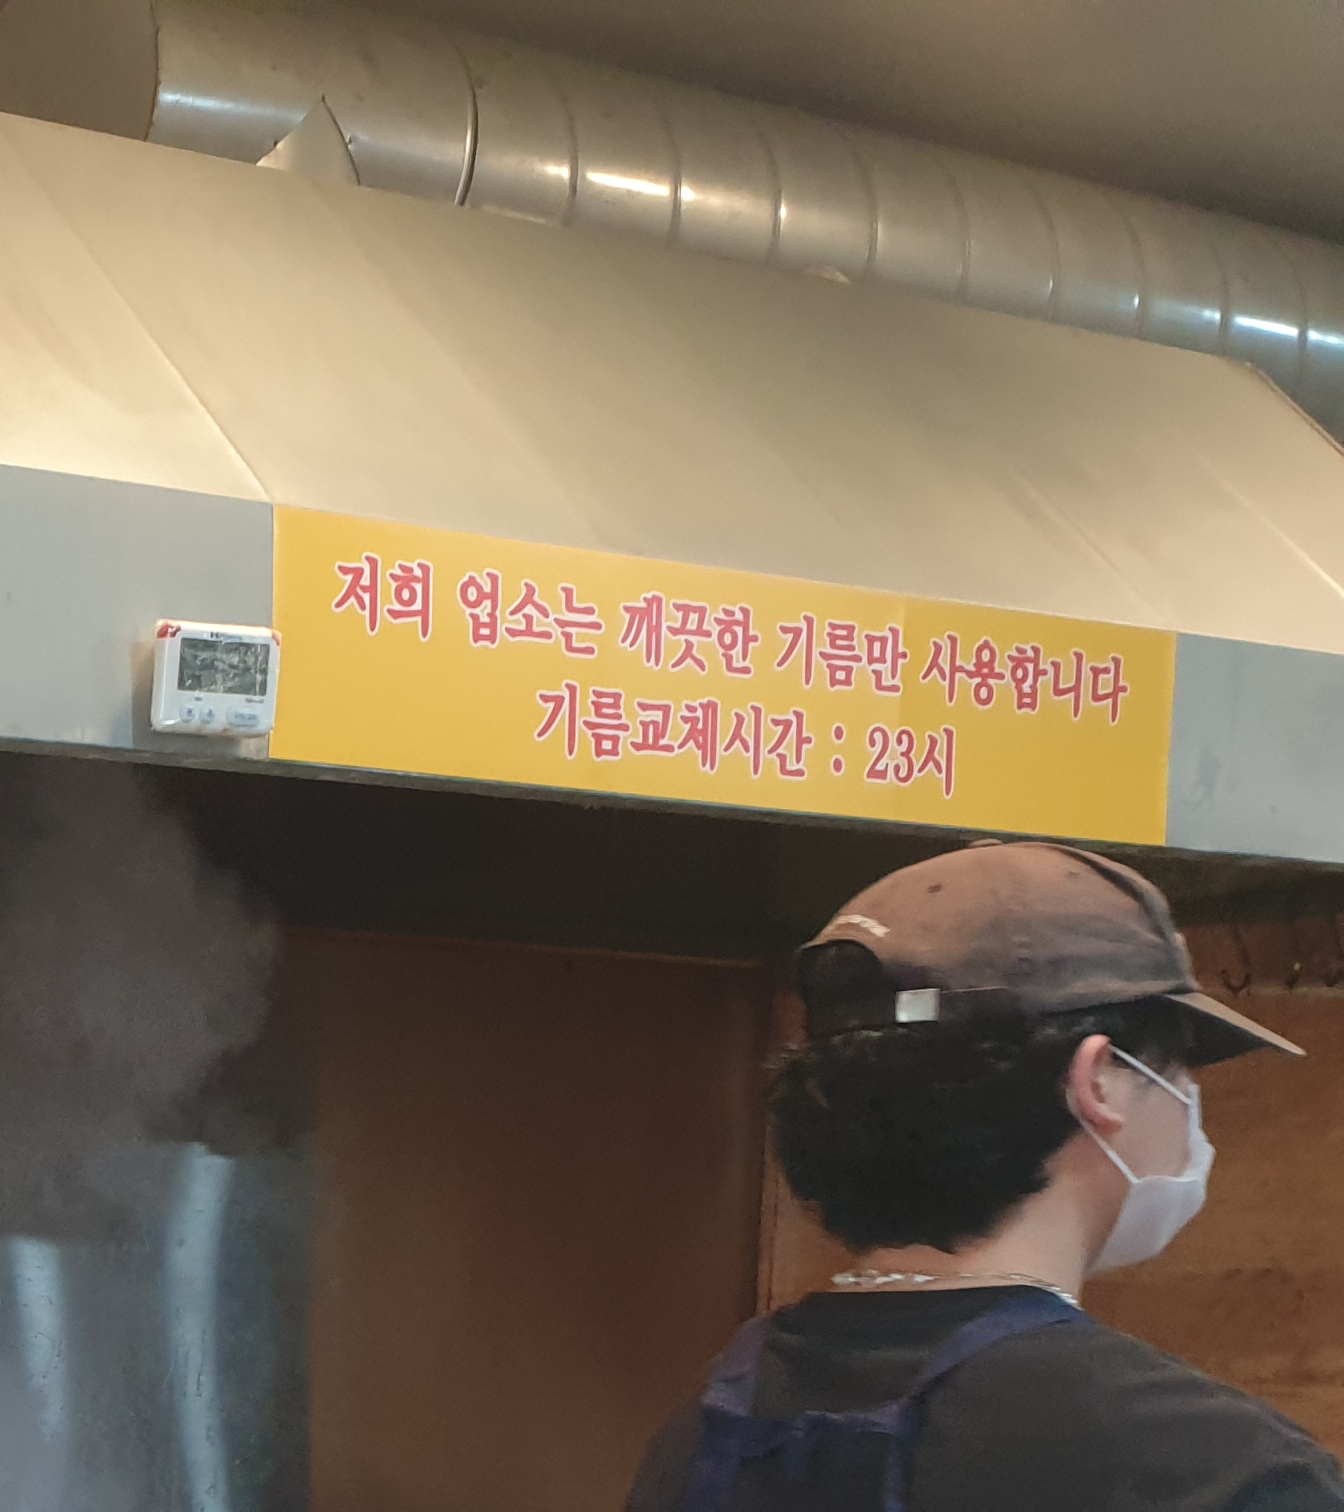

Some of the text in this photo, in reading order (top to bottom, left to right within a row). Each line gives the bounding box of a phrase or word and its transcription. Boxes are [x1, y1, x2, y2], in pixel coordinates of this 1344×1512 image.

[333, 552, 1128, 724] 저희 업소는 깨끗한 기름만 사용합니다
[535, 680, 812, 778] 기름교체시간
[865, 726, 956, 798] 23시
